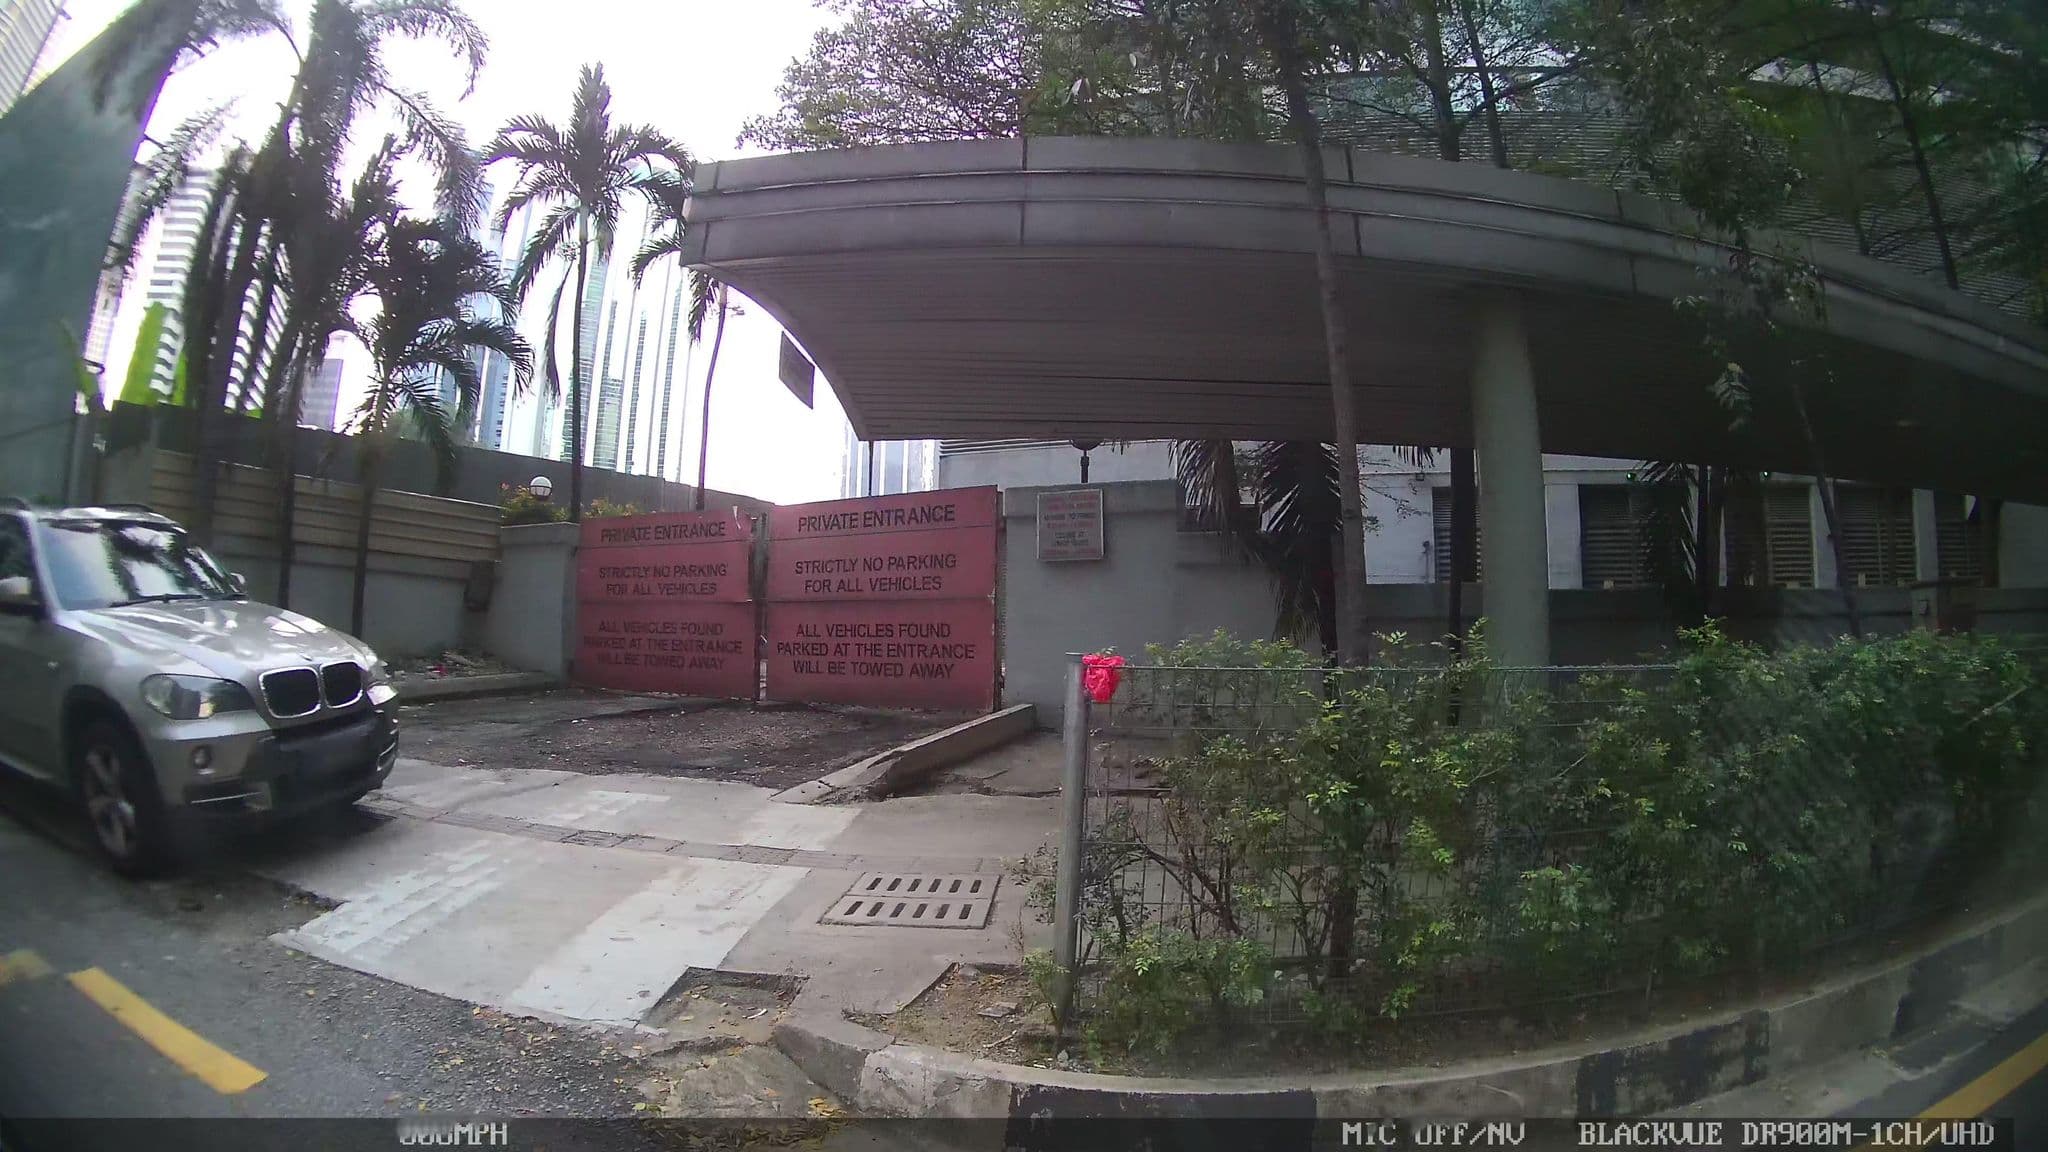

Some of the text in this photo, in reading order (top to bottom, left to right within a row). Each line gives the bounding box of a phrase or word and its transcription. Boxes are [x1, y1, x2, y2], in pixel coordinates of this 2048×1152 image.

[798, 504, 956, 532] PRIVATE ENTRANCE
[600, 521, 726, 543] PRIVATE ENTRANCE
[599, 563, 728, 579] STRICTLY NO PARKING
[795, 553, 957, 575] STRICTLY NO PARKING
[606, 582, 717, 596] FOR ALL VEHICLES
[804, 575, 942, 594] FOR ALL VEHICLES
[598, 620, 620, 634] ALL
[681, 622, 724, 635] FOUND
[796, 623, 951, 639] ALL VEHICLES FOUND
[629, 637, 643, 650] AT
[647, 638, 670, 651] THE
[671, 638, 743, 655] ENTRANCE
[777, 642, 976, 660] PARKED AT THE ENTRANCE
[624, 653, 640, 666] BE
[642, 653, 685, 669] TOWED
[688, 655, 726, 671] AWAY
[793, 660, 956, 679] WILL BE TOWED AWAY
